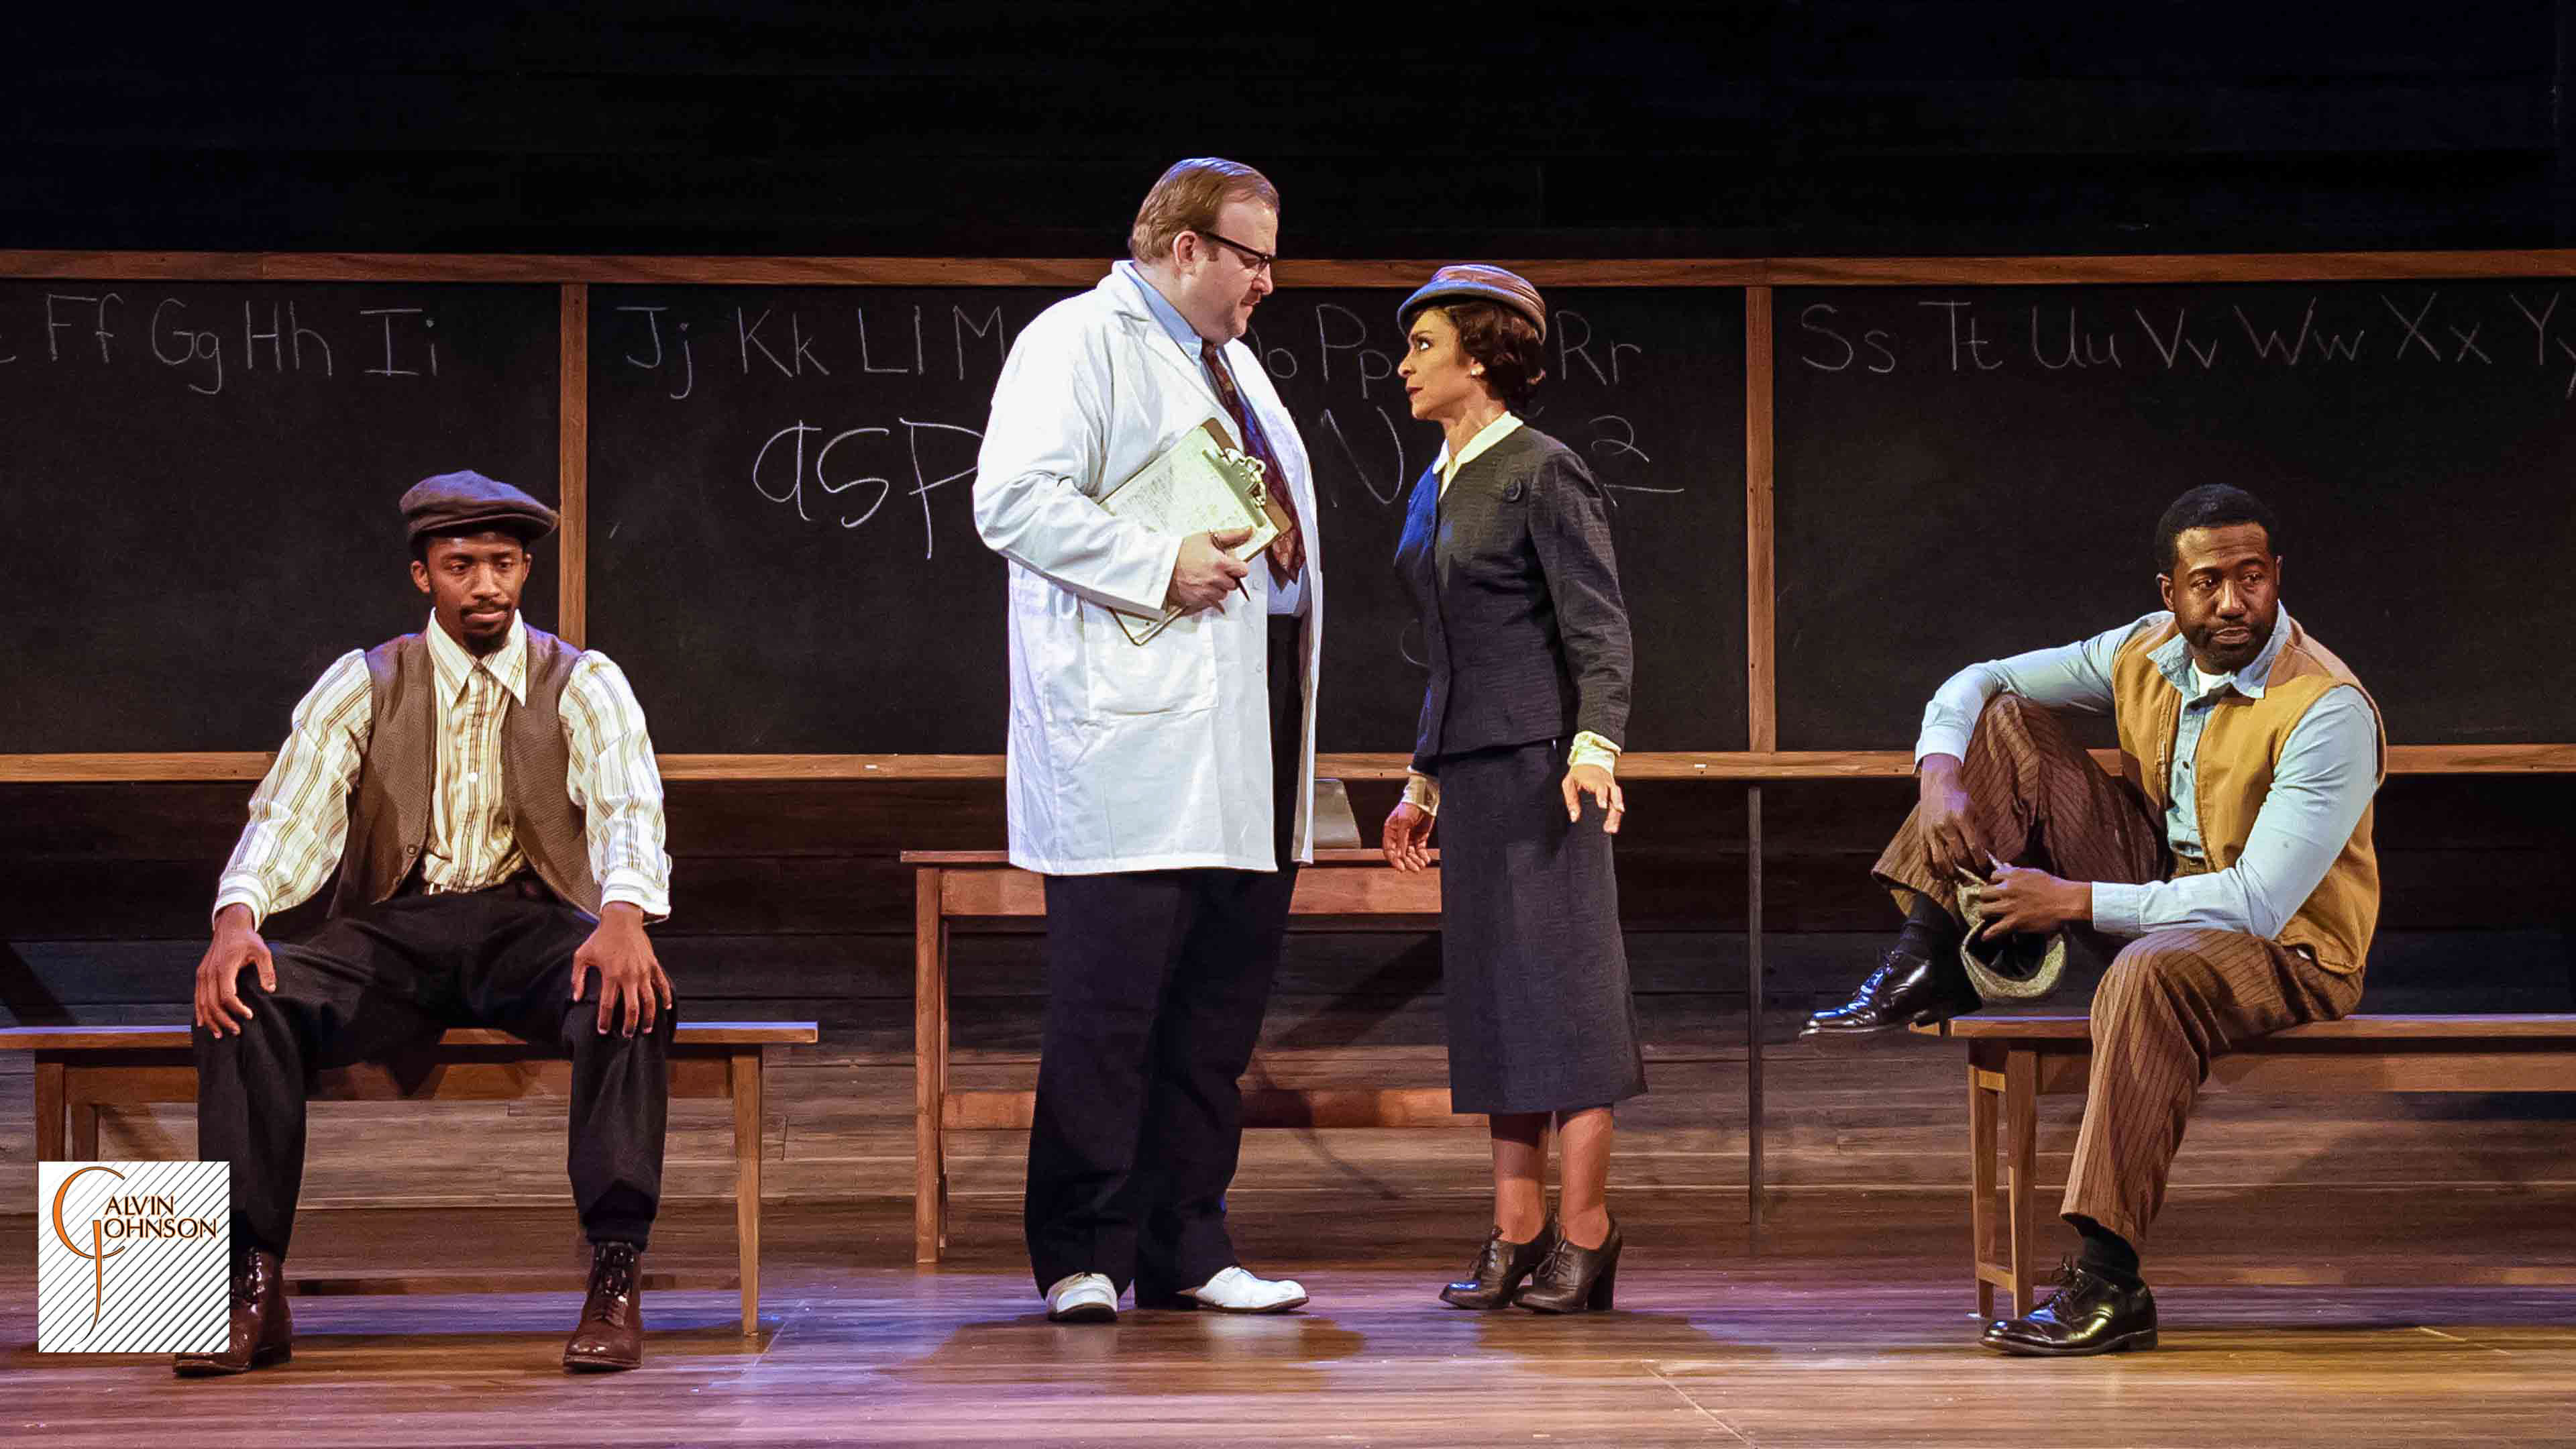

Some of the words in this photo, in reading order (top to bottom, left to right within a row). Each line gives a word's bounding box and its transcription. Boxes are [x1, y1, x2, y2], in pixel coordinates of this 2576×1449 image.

[46, 292, 125, 364] Ff
[151, 297, 222, 394] Gg
[246, 299, 333, 377] Hh
[359, 307, 439, 376] Ii
[615, 306, 693, 400] Jj
[737, 306, 831, 379] Kk
[1315, 303, 1393, 400] Pp
[1555, 311, 1643, 385] Rr
[1801, 304, 1896, 372] Ss
[1918, 300, 2004, 371] Tt
[2033, 306, 2123, 369] Uu
[2135, 308, 2217, 369] Vv
[2234, 296, 2365, 366] Ww
[2381, 291, 2493, 364] Xx
